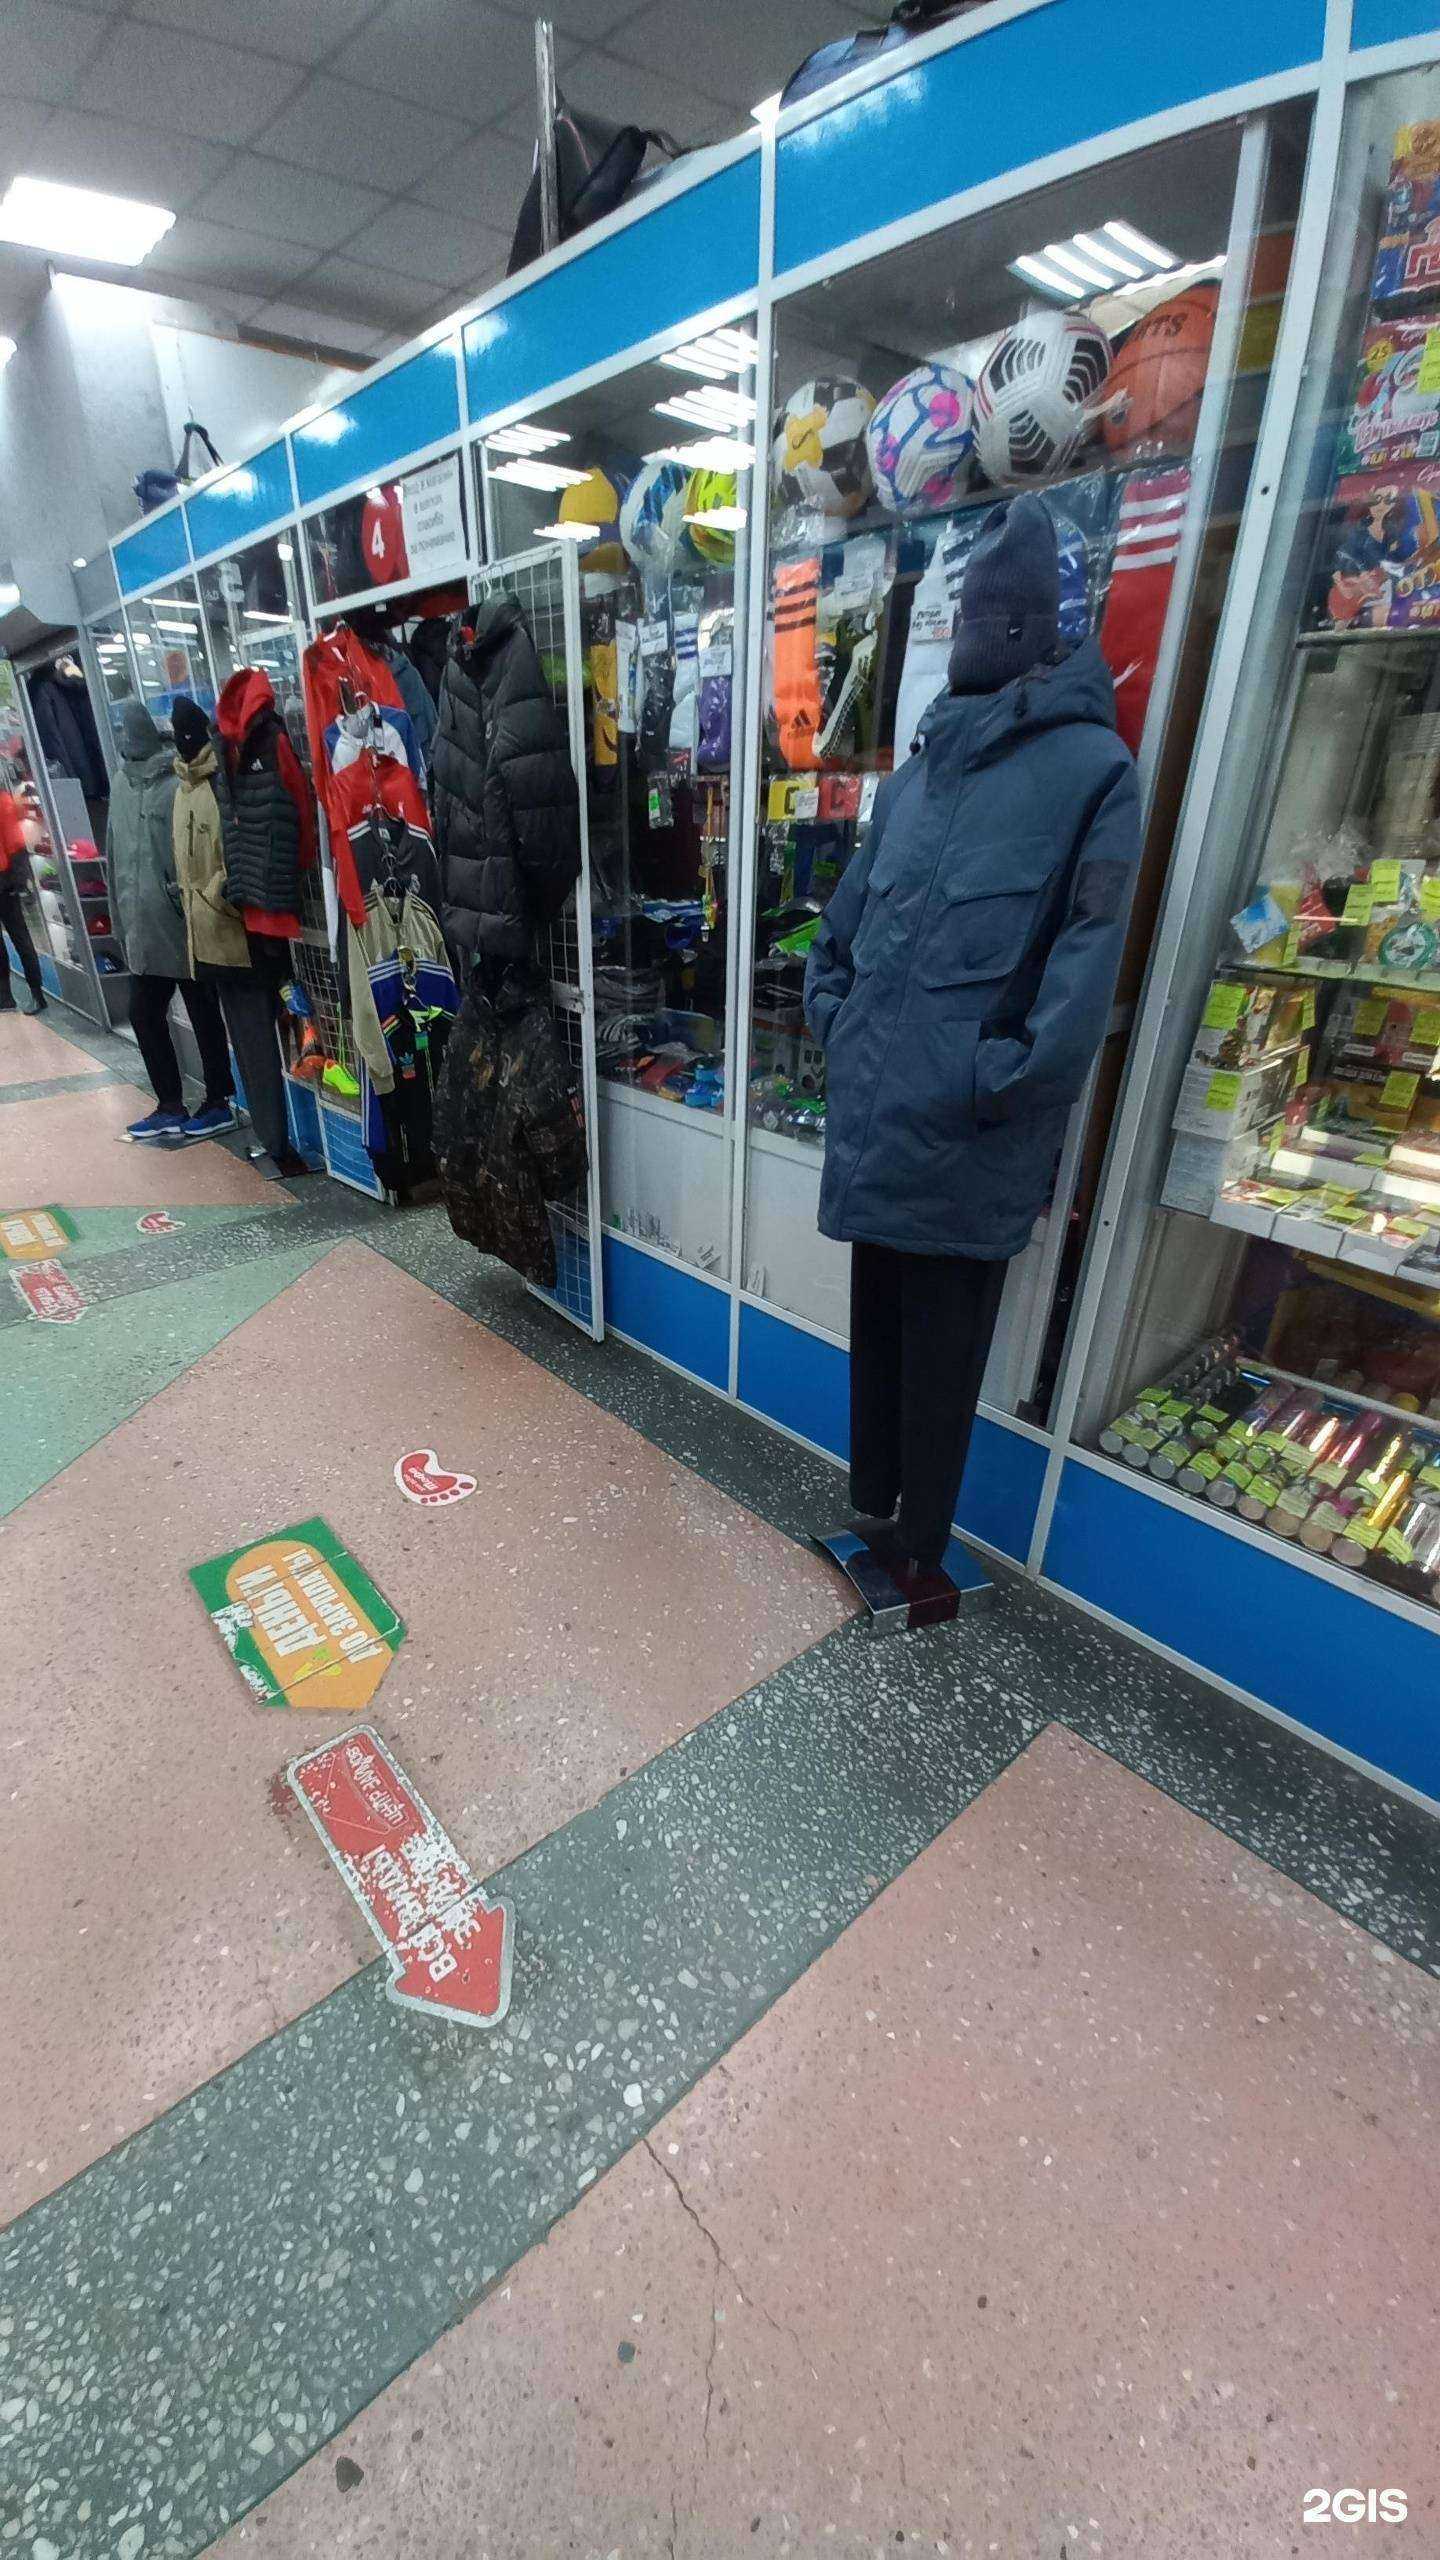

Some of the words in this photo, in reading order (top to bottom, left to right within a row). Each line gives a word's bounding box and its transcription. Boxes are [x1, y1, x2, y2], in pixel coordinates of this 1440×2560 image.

[371, 519, 385, 560] 4
[234, 1564, 328, 1658] ДЕНЬГИ
[282, 1548, 359, 1636] ЗАРПЛАТЫ
[338, 1629, 384, 1664] ДО
